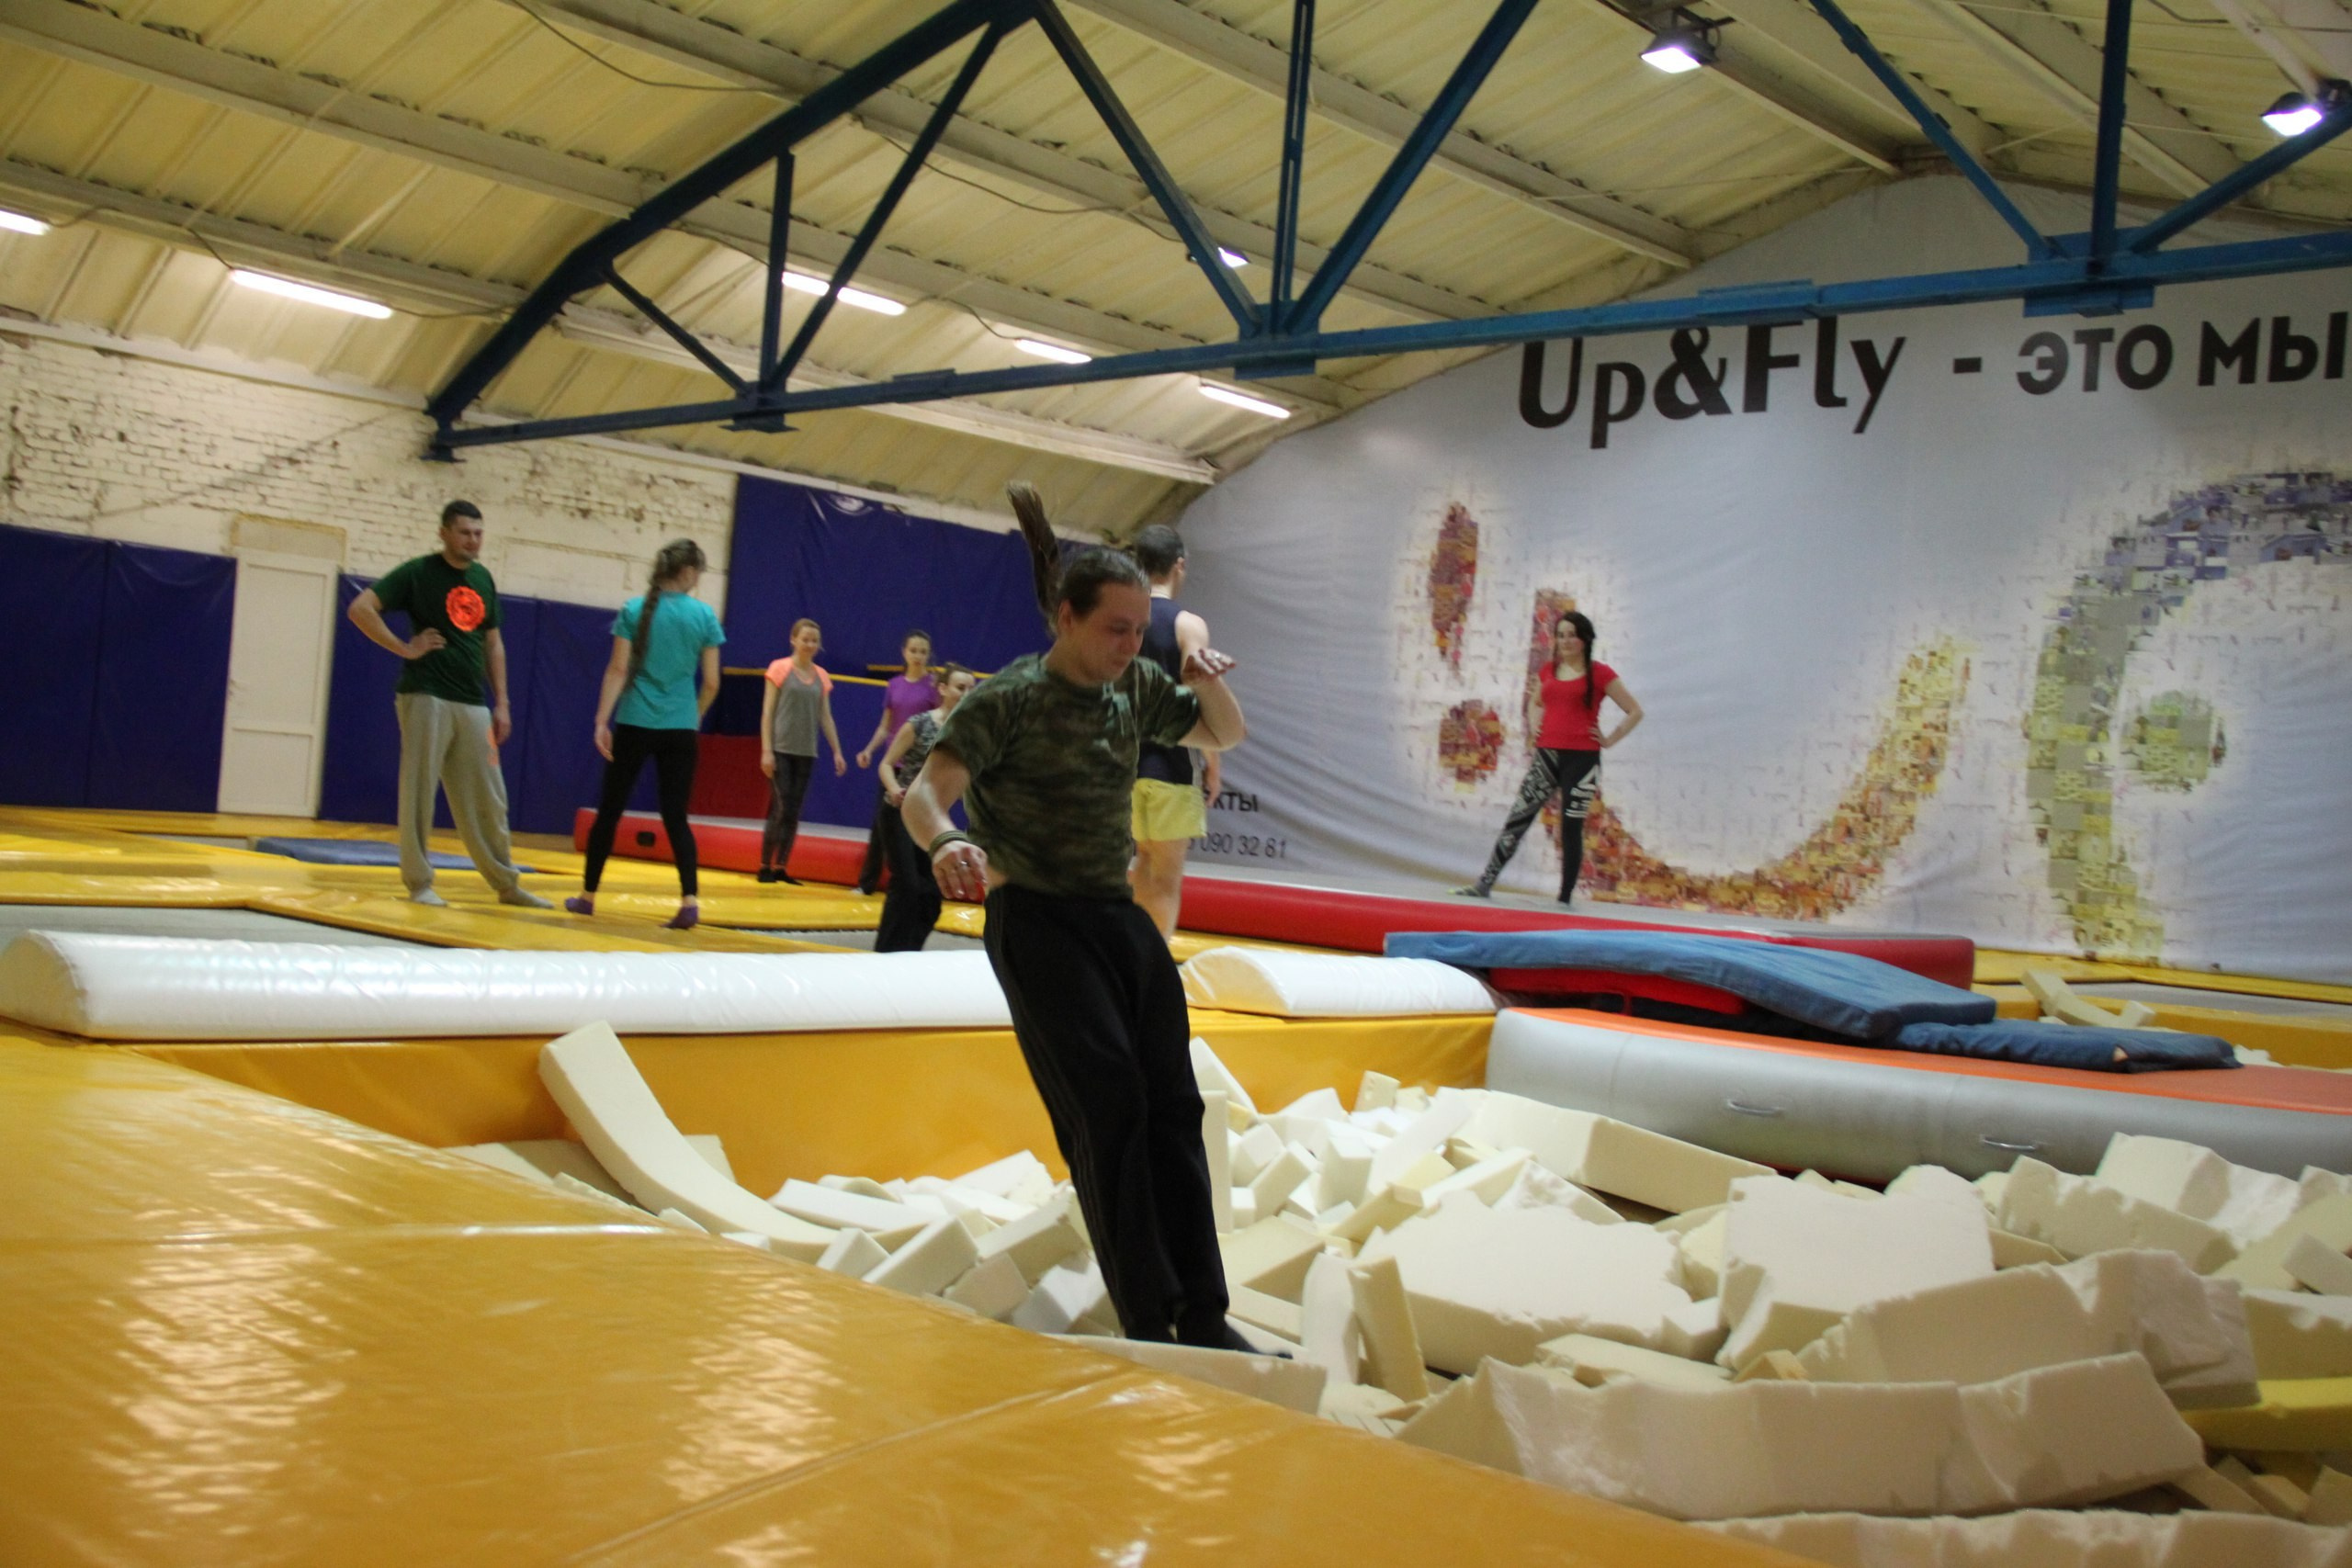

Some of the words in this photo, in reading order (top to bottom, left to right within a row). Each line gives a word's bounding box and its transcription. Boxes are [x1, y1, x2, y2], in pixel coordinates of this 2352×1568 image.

[1519, 315, 1907, 449] Up&Fly
[2016, 323, 2174, 396] это
[2197, 310, 2349, 387] мы
[1238, 834, 1261, 857] 32
